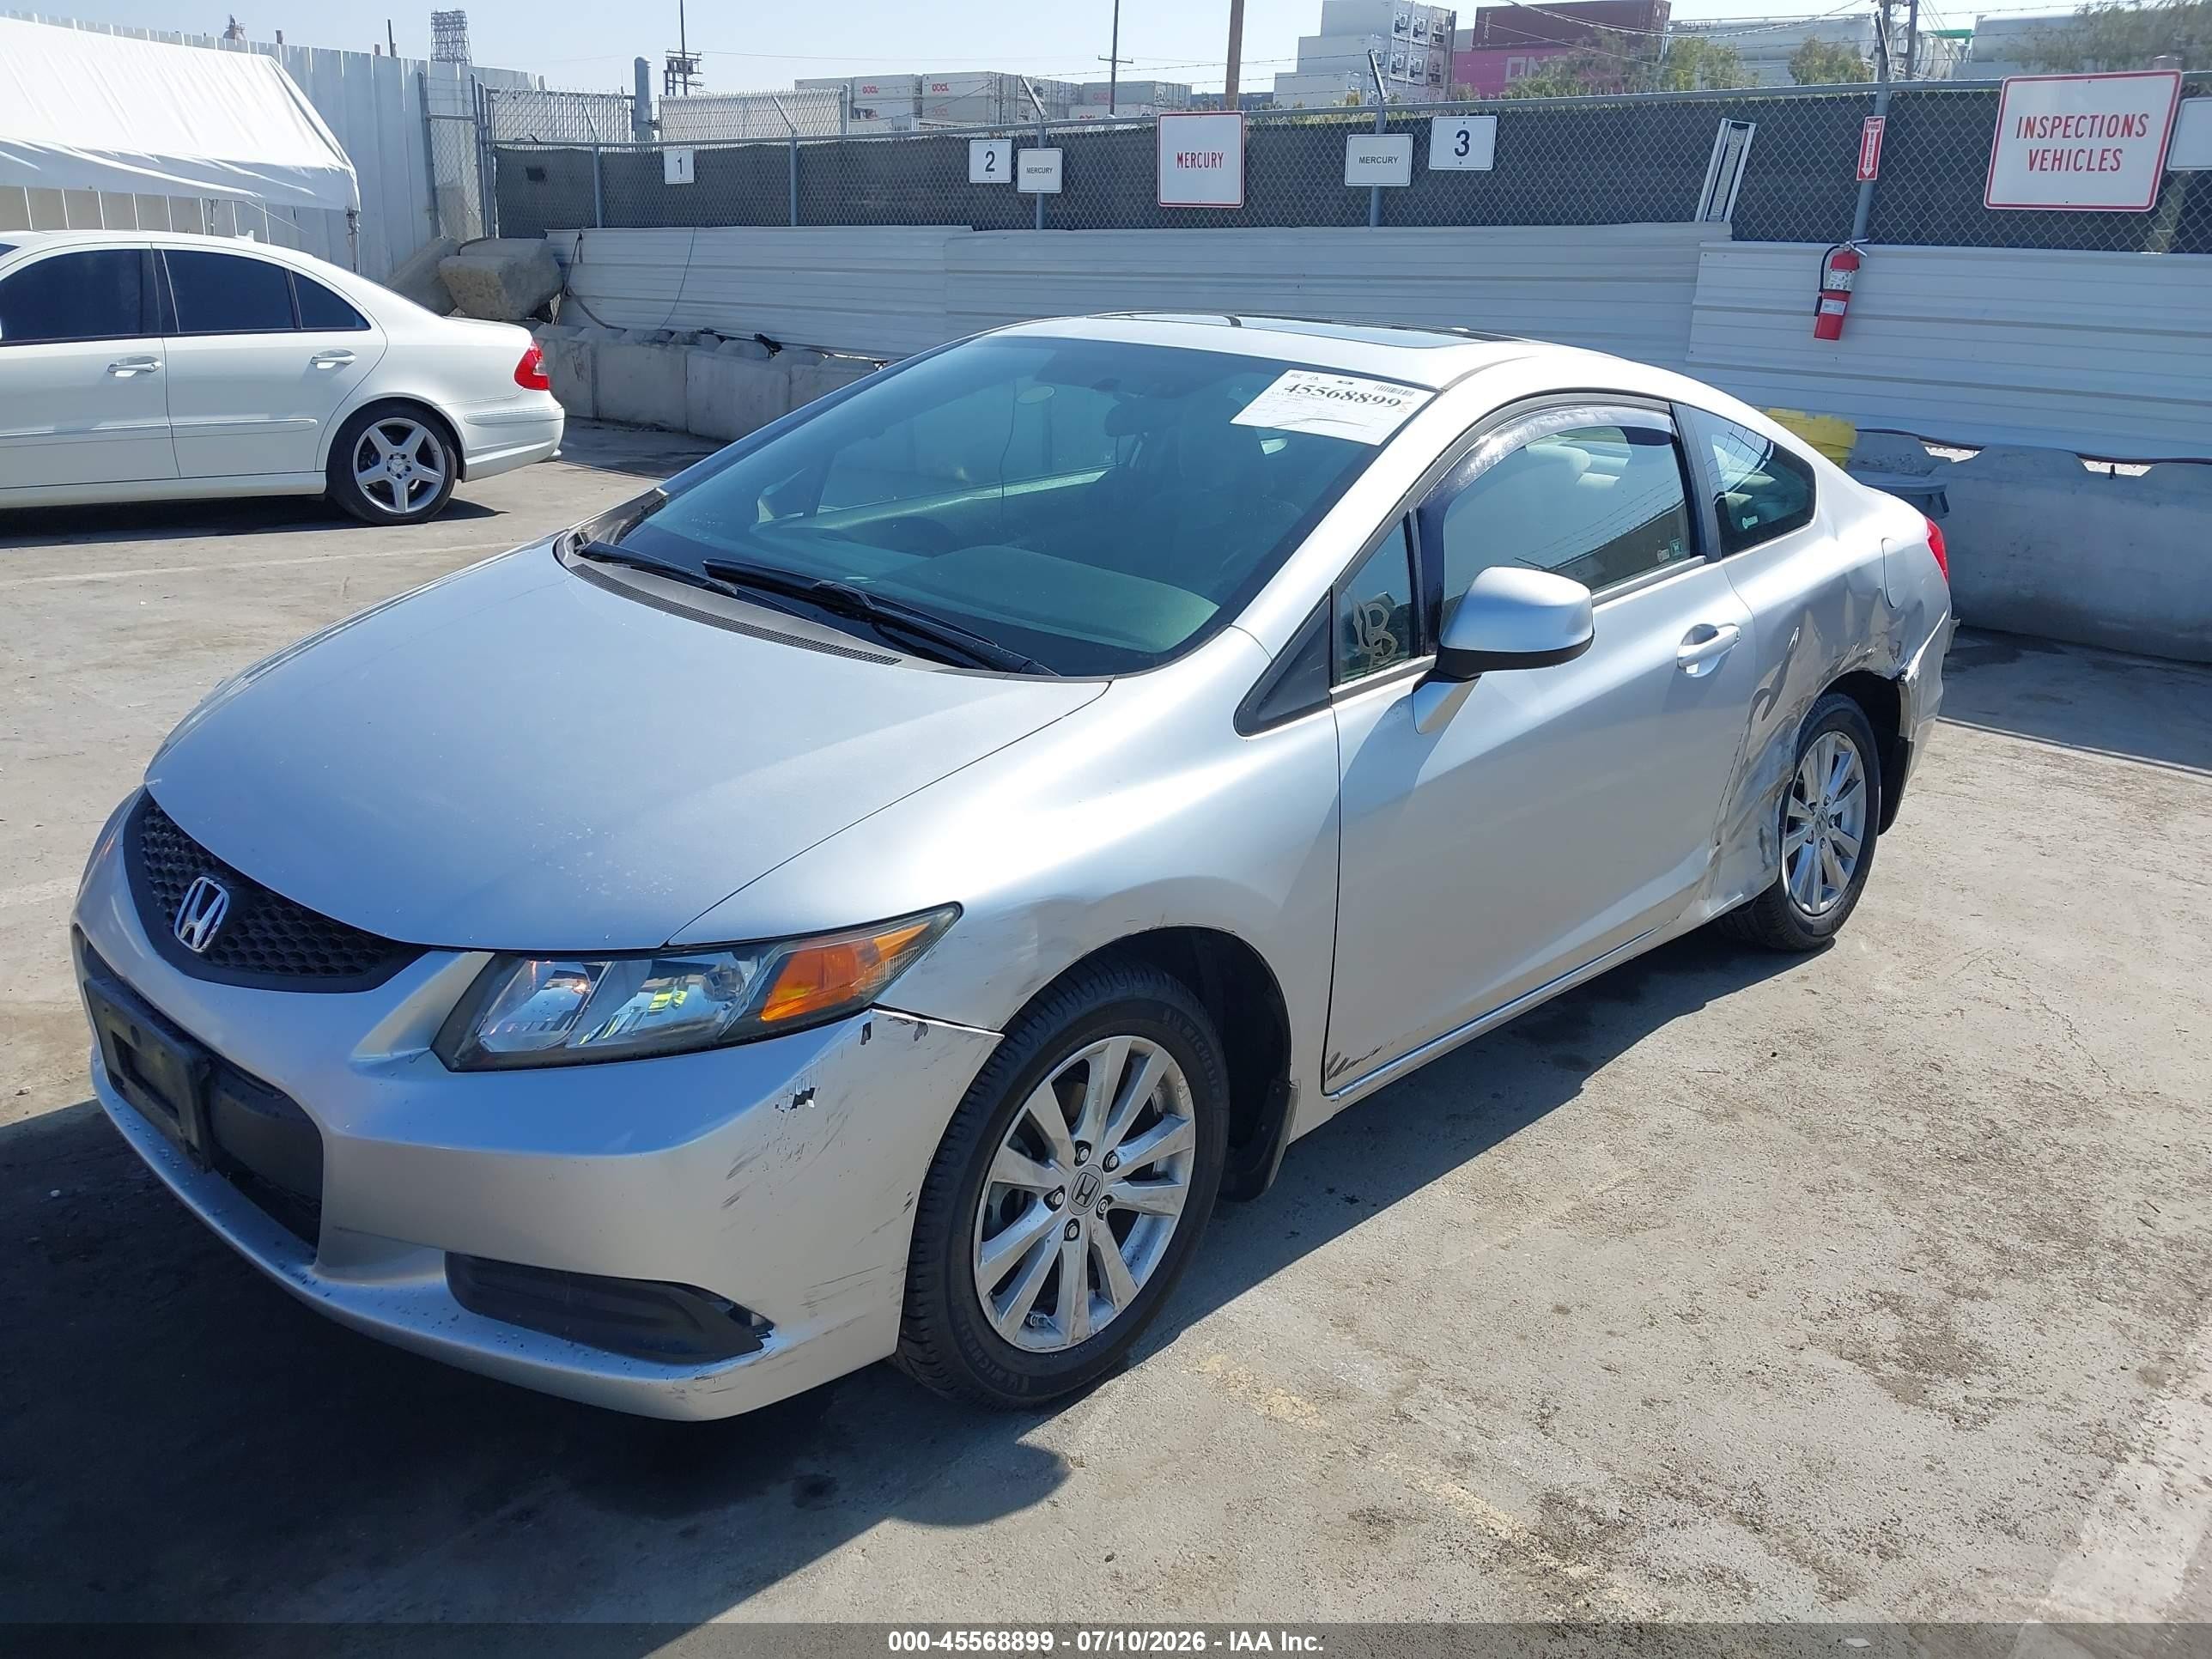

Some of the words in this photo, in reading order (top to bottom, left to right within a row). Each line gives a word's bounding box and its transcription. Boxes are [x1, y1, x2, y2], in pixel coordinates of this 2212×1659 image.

[2015, 112, 2150, 139] INSPECTIONS
[1454, 129, 1470, 157] 3
[676, 156, 684, 174] 1
[985, 150, 995, 173] 2
[1026, 166, 1054, 175] MERCURY
[1176, 152, 1224, 169] MERCURY
[1358, 155, 1399, 165] MERCURY
[2027, 148, 2124, 172] VEHICLES
[1284, 383, 1402, 408] 45568899
